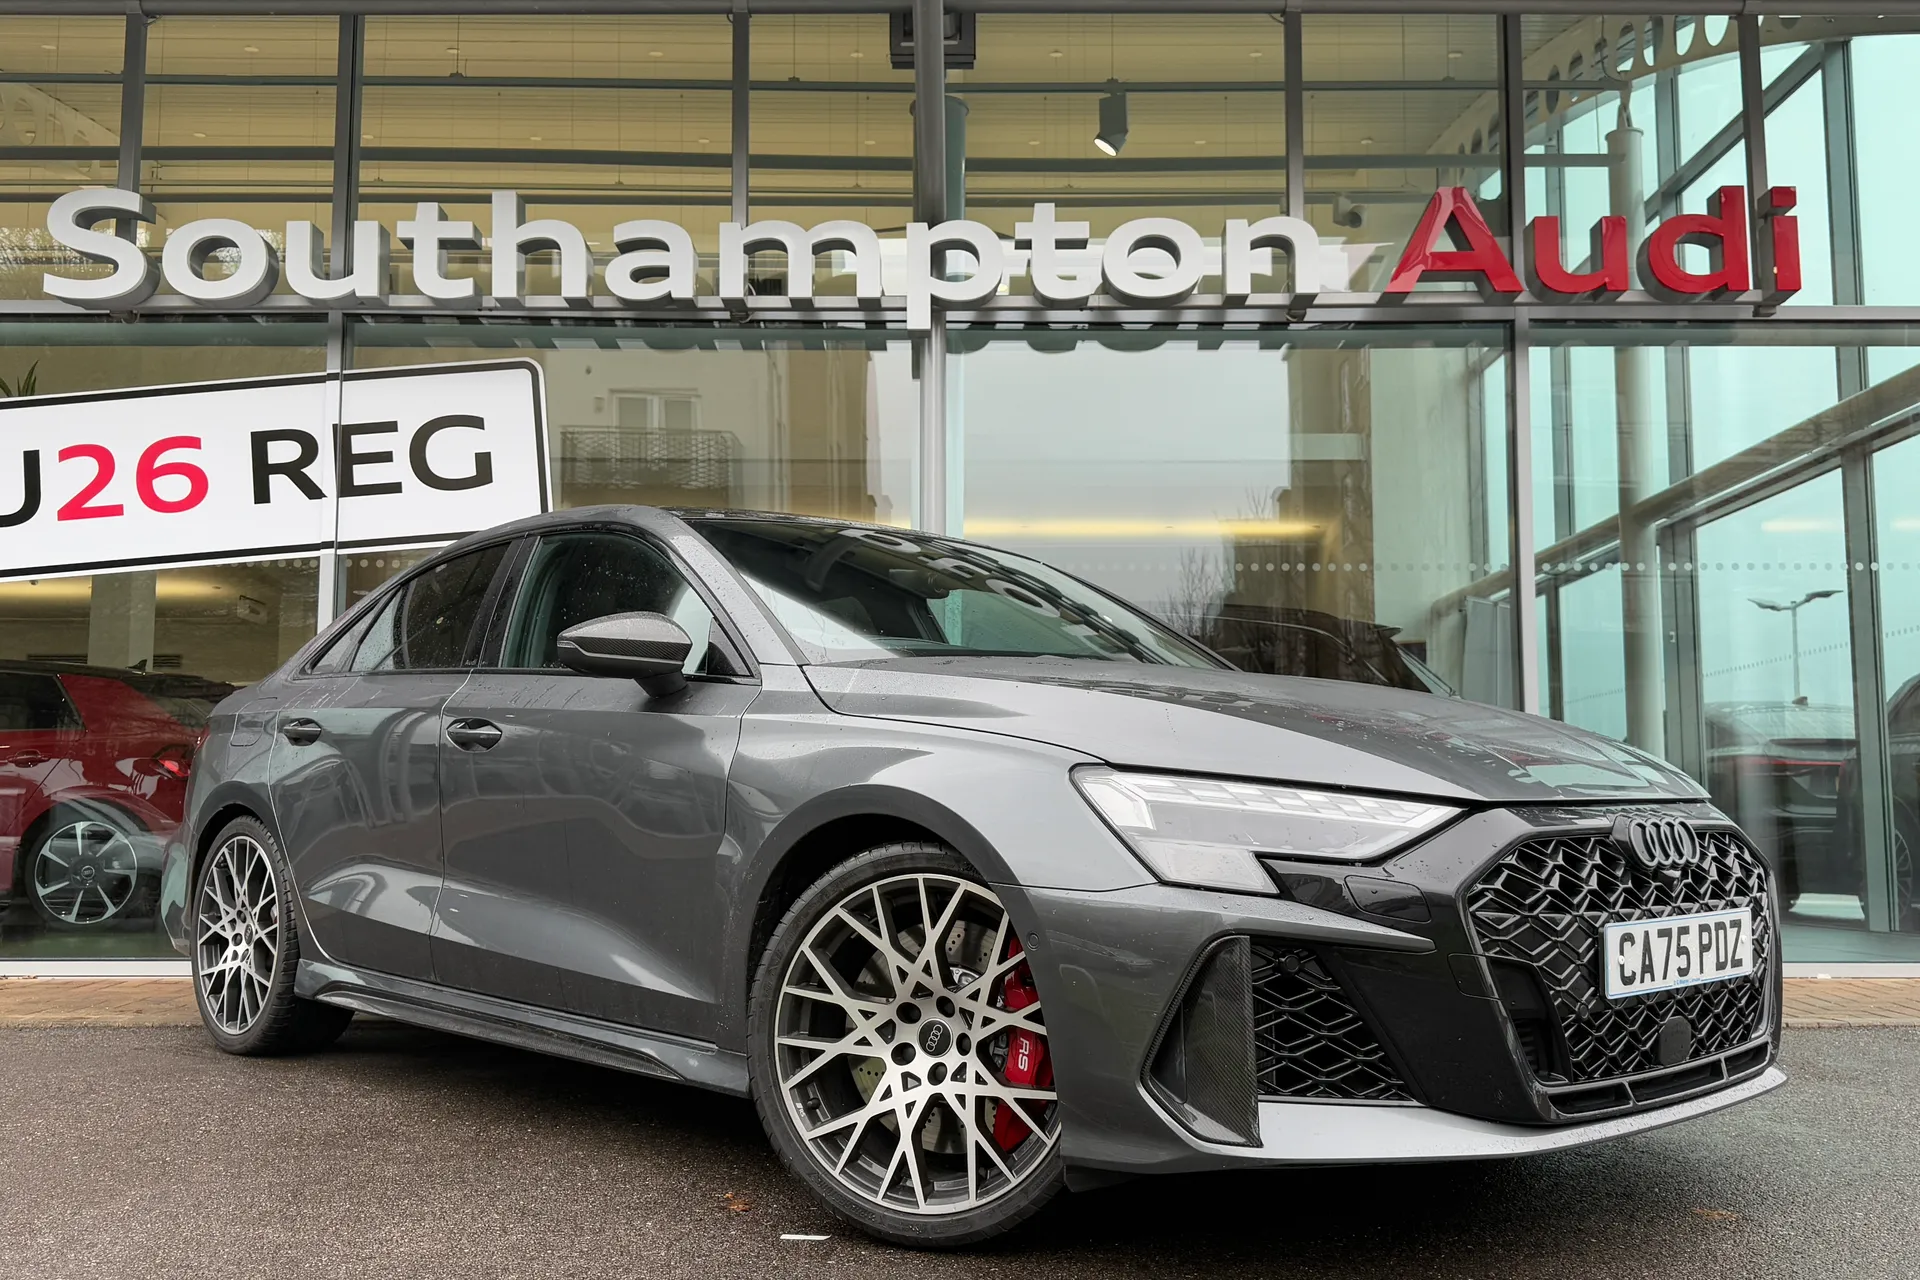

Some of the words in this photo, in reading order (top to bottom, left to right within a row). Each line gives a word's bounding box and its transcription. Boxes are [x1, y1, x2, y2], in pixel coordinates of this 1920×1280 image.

[43, 187, 1320, 332] Southampton
[1384, 185, 1803, 302] Audi
[250, 415, 494, 504] REG
[1618, 925, 1691, 987] CA75
[1698, 918, 1744, 976] PDZ
[1018, 1037, 1031, 1072] RS
